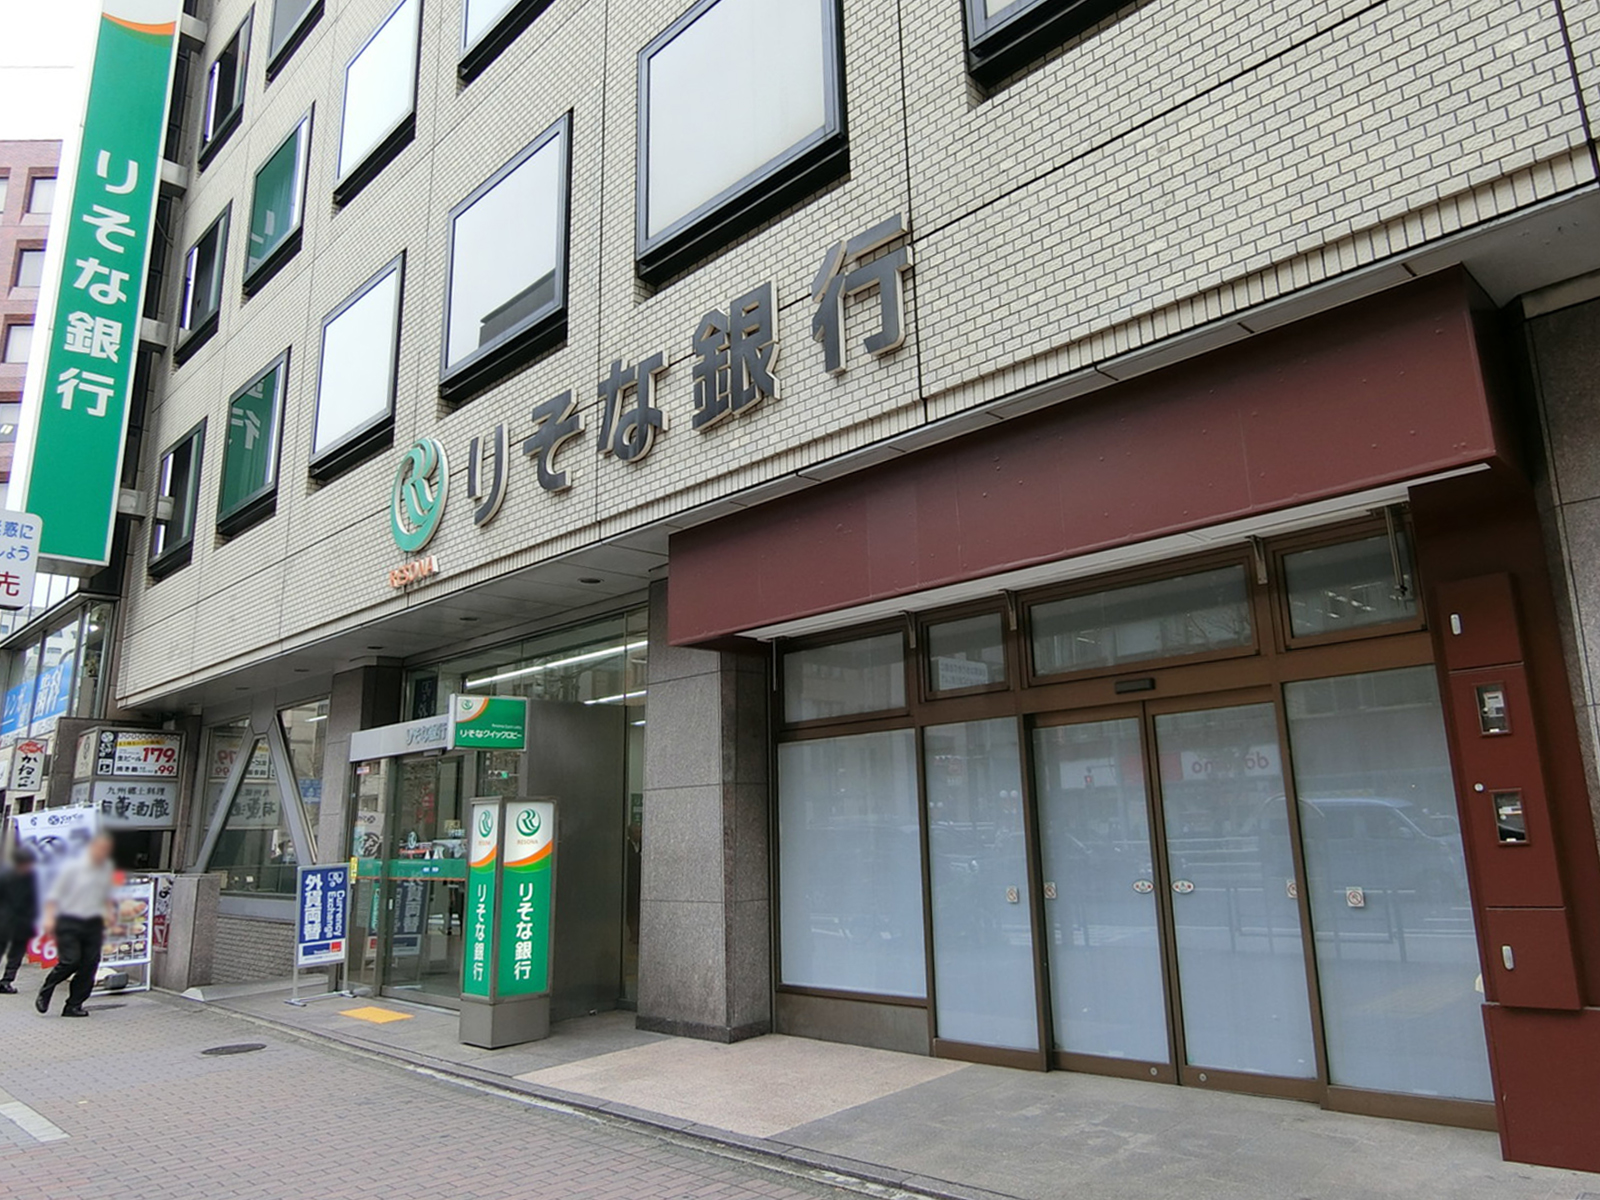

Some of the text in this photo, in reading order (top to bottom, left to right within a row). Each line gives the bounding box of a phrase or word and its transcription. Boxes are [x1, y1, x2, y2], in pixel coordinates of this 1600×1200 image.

[56, 149, 139, 417] りそな銀行
[467, 212, 914, 527] りそな銀行
[460, 729, 522, 739] りそなクイックロビー
[107, 786, 165, 796] 九州郷土料理
[304, 873, 323, 941] 外貨両替
[324, 891, 336, 938] Exchange
[334, 890, 345, 936] Currency
[473, 884, 486, 981] りそな銀行
[514, 883, 533, 980] りそな銀行
